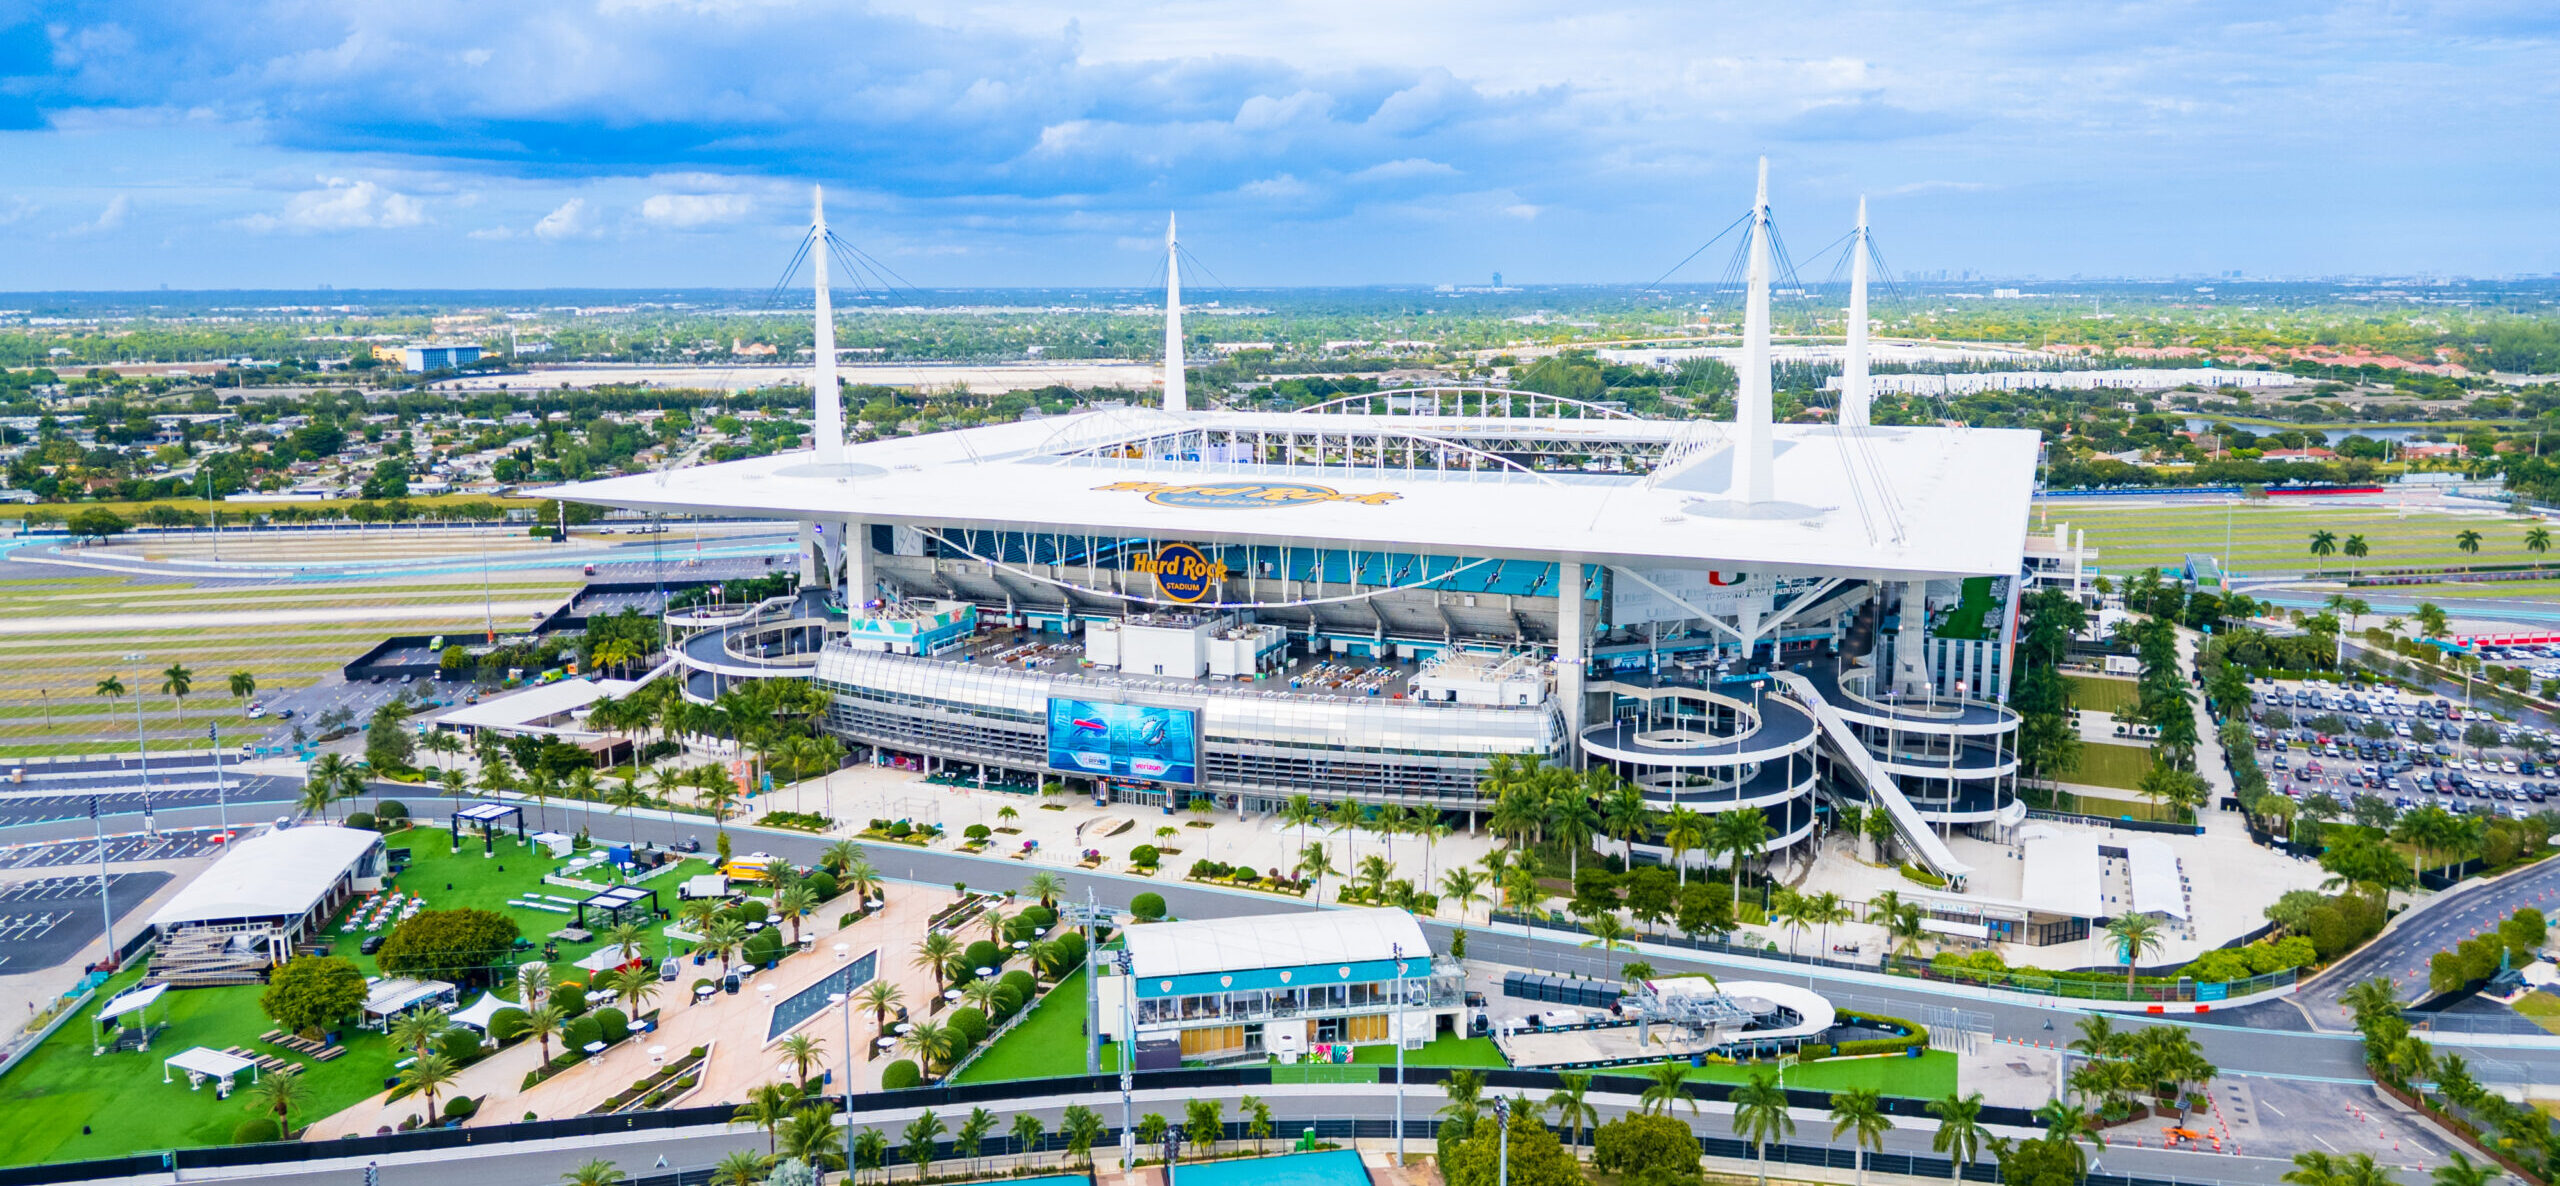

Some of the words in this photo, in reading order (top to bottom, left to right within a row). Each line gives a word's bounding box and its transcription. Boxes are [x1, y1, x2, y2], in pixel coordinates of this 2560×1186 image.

[1090, 481, 1265, 497] Hard
[1246, 486, 1403, 506] Rock
[1133, 552, 1180, 575] Hard
[1182, 555, 1229, 583] Rock
[1166, 582, 1200, 592] STADIUM
[1135, 763, 1162, 772] verizon
